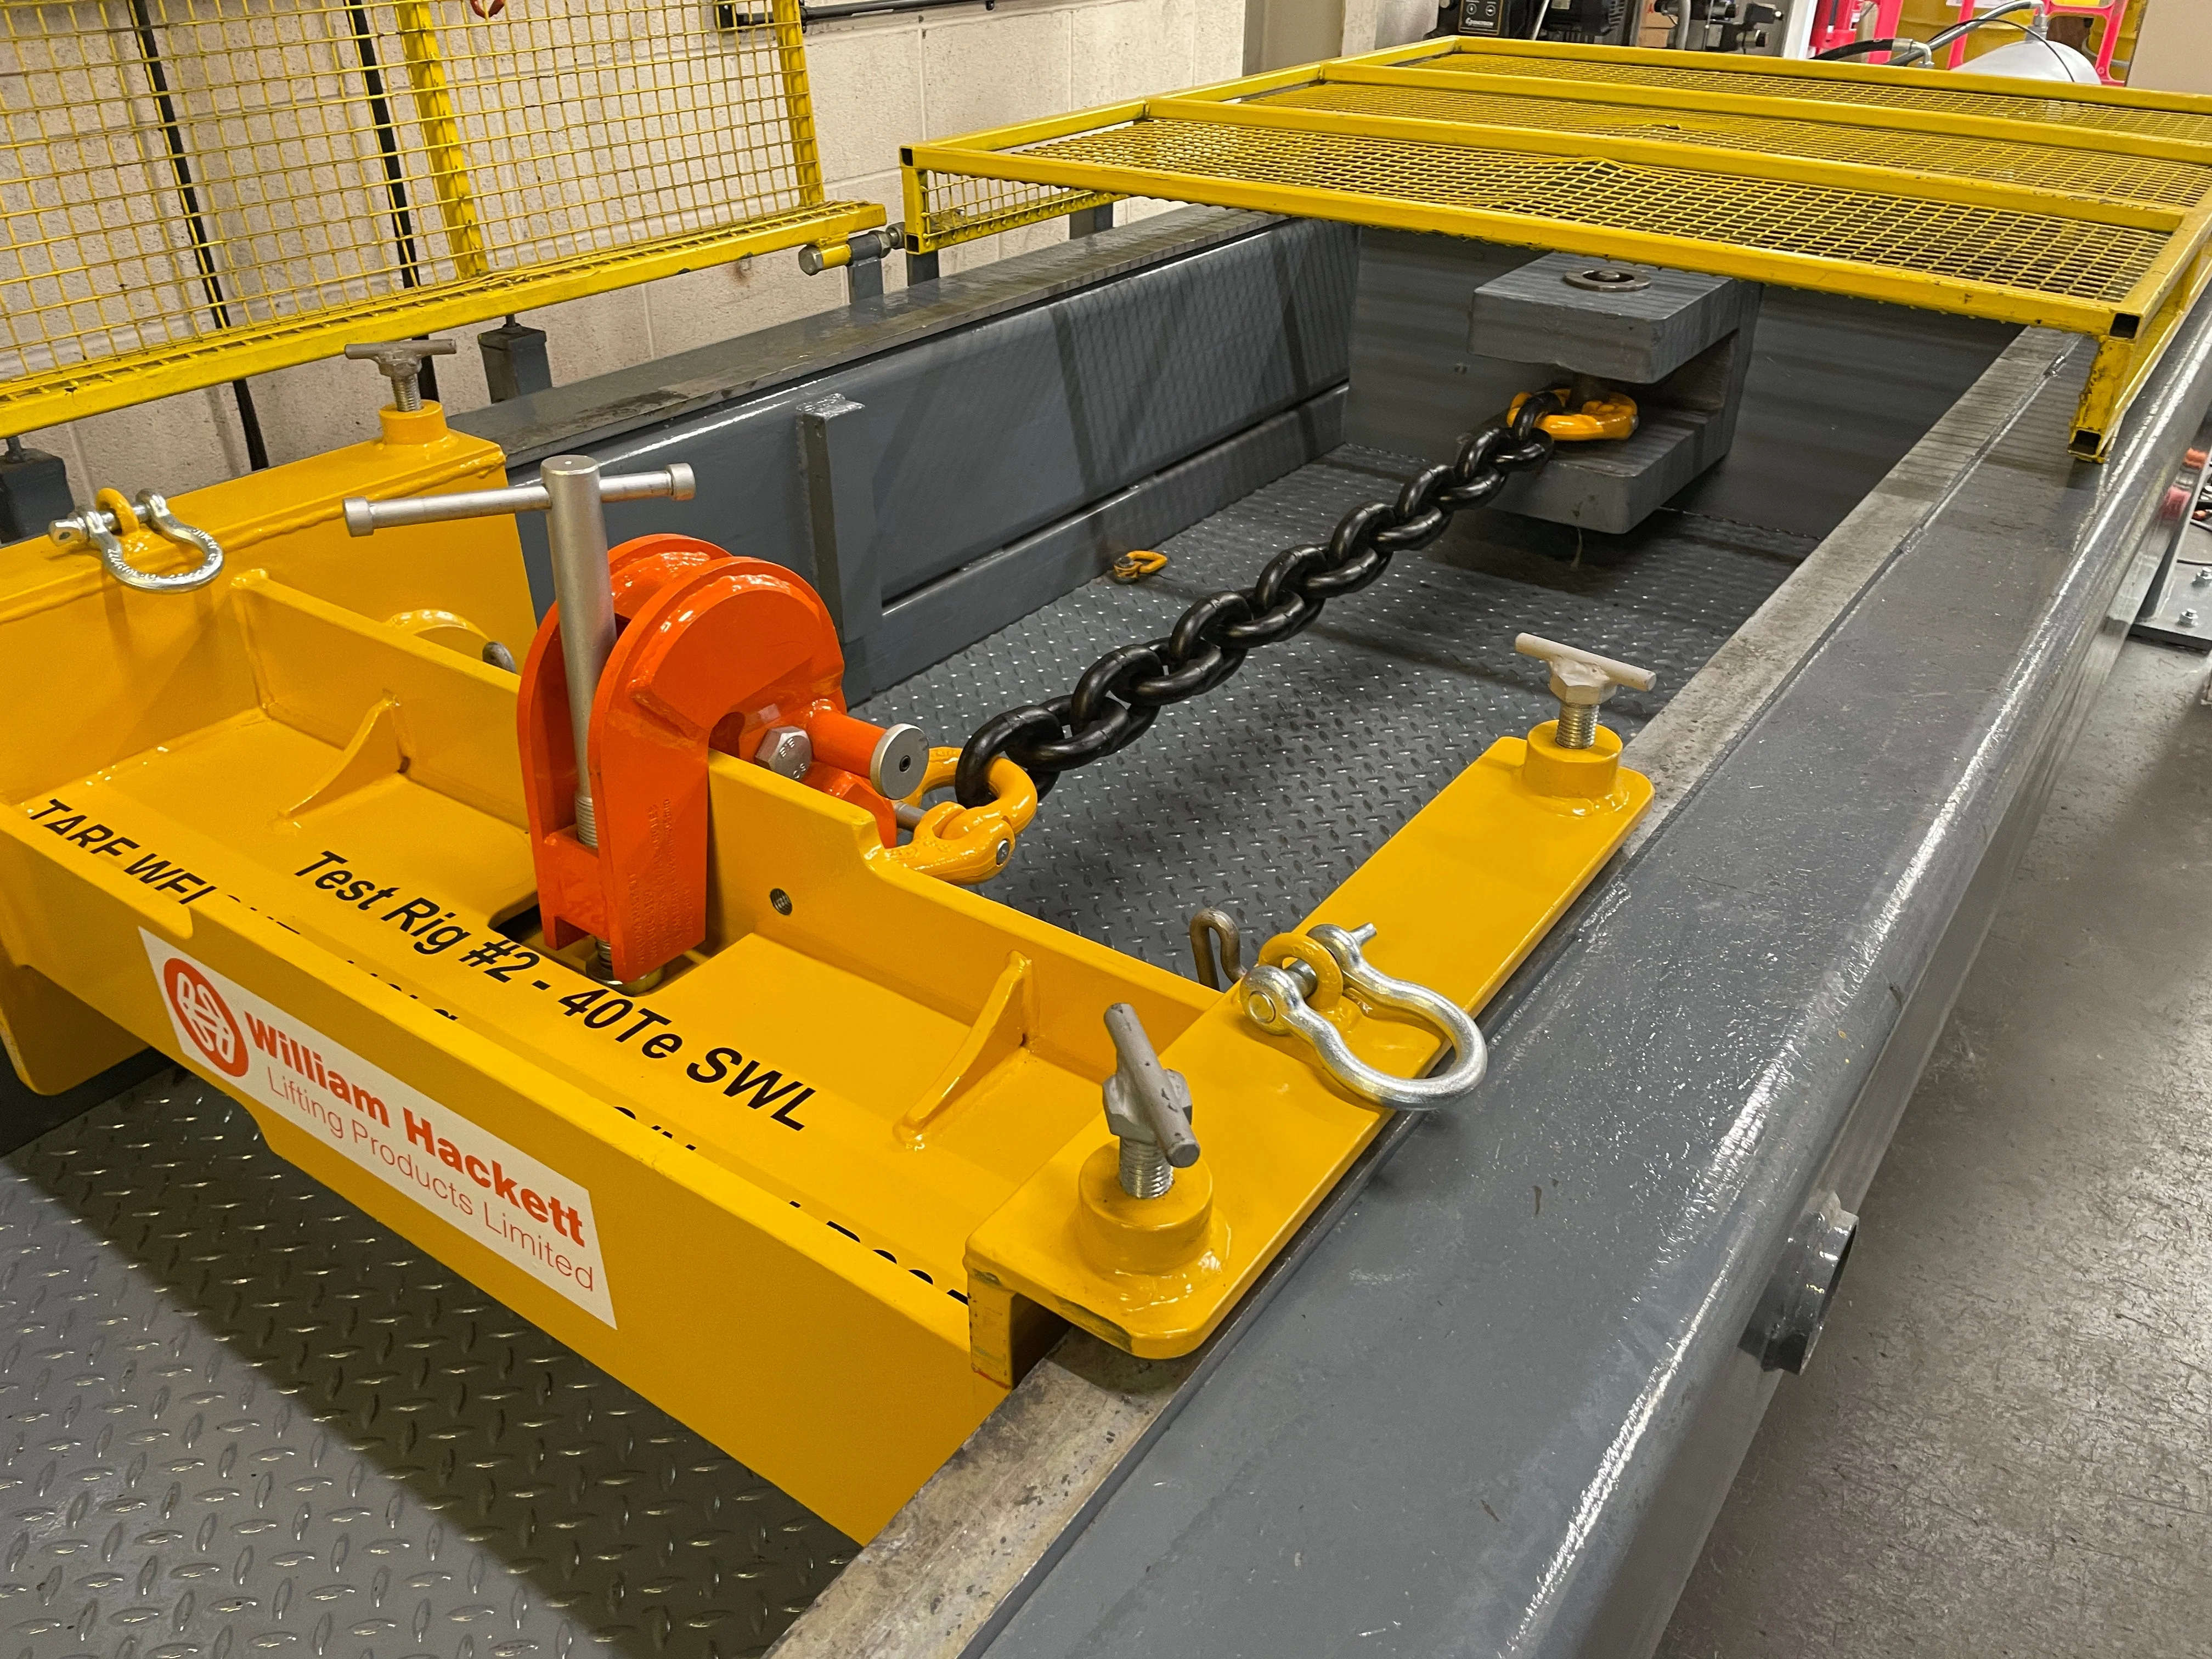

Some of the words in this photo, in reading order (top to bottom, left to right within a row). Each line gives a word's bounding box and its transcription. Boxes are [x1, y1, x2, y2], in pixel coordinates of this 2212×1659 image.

[295, 850, 399, 911] Test
[380, 897, 472, 955] Rig
[459, 938, 539, 983] #2
[558, 989, 684, 1059] 40Te
[686, 1047, 816, 1131] SWL
[245, 1011, 391, 1128] William
[403, 1107, 585, 1248] Hackett
[267, 1066, 344, 1139] Lifting
[352, 1119, 473, 1215] Products
[484, 1201, 594, 1292] Limited
